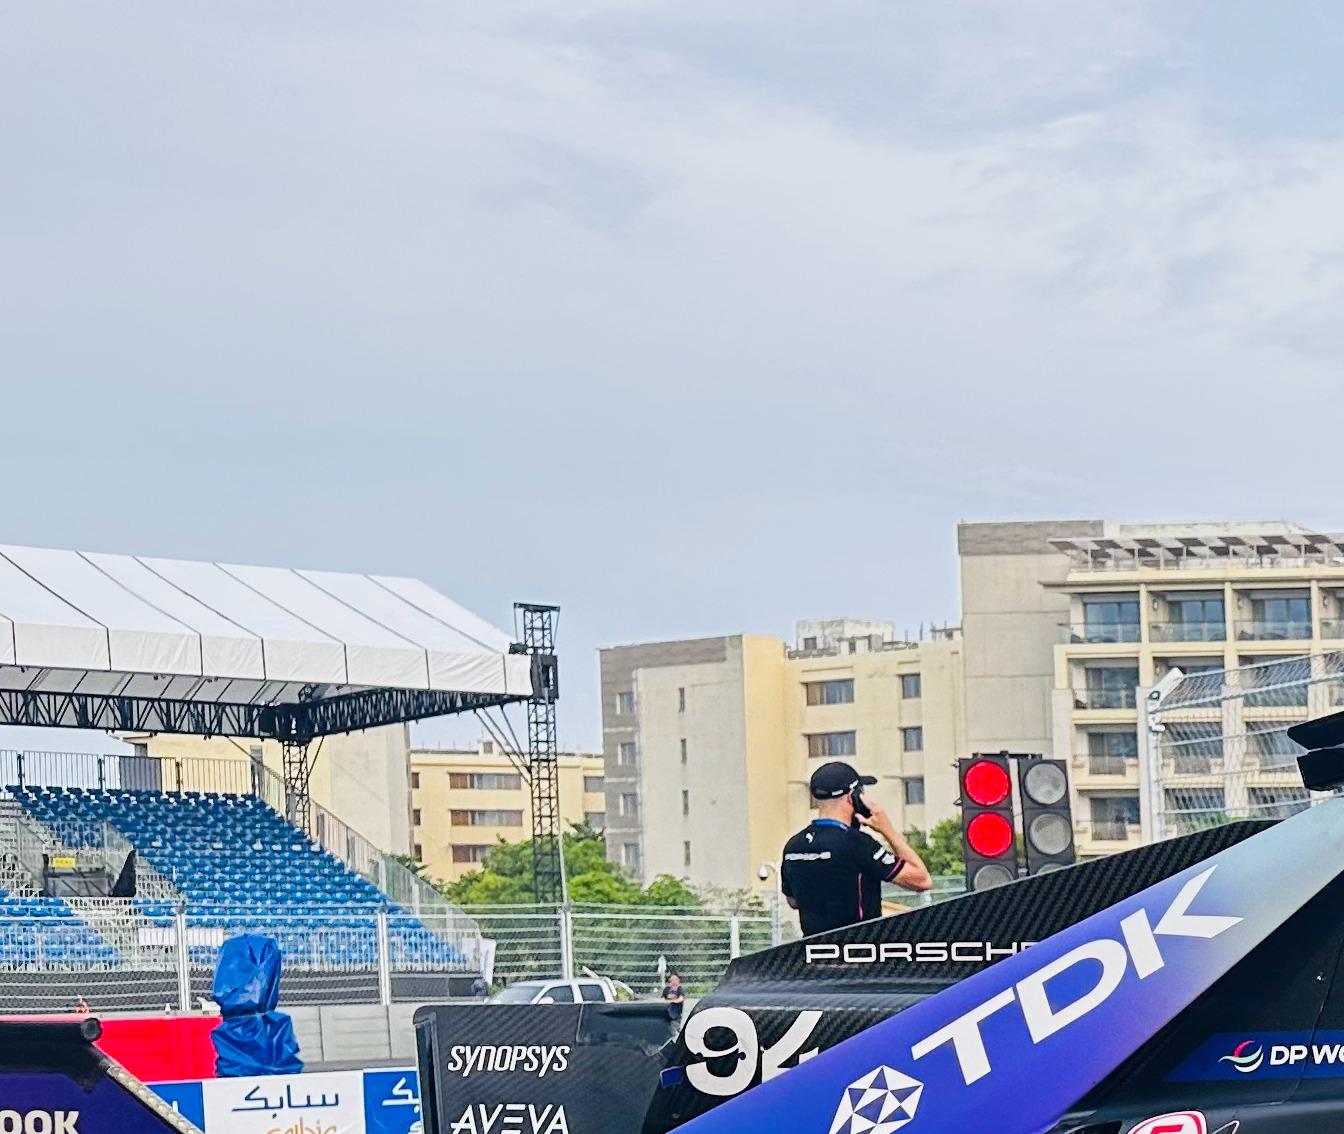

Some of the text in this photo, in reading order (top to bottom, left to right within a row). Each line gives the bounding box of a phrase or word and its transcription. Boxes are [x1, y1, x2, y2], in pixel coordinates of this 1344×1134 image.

[911, 864, 1244, 1085] TDK
[447, 1045, 571, 1078] SYNOPSYS
[1269, 1044, 1308, 1066] DP
